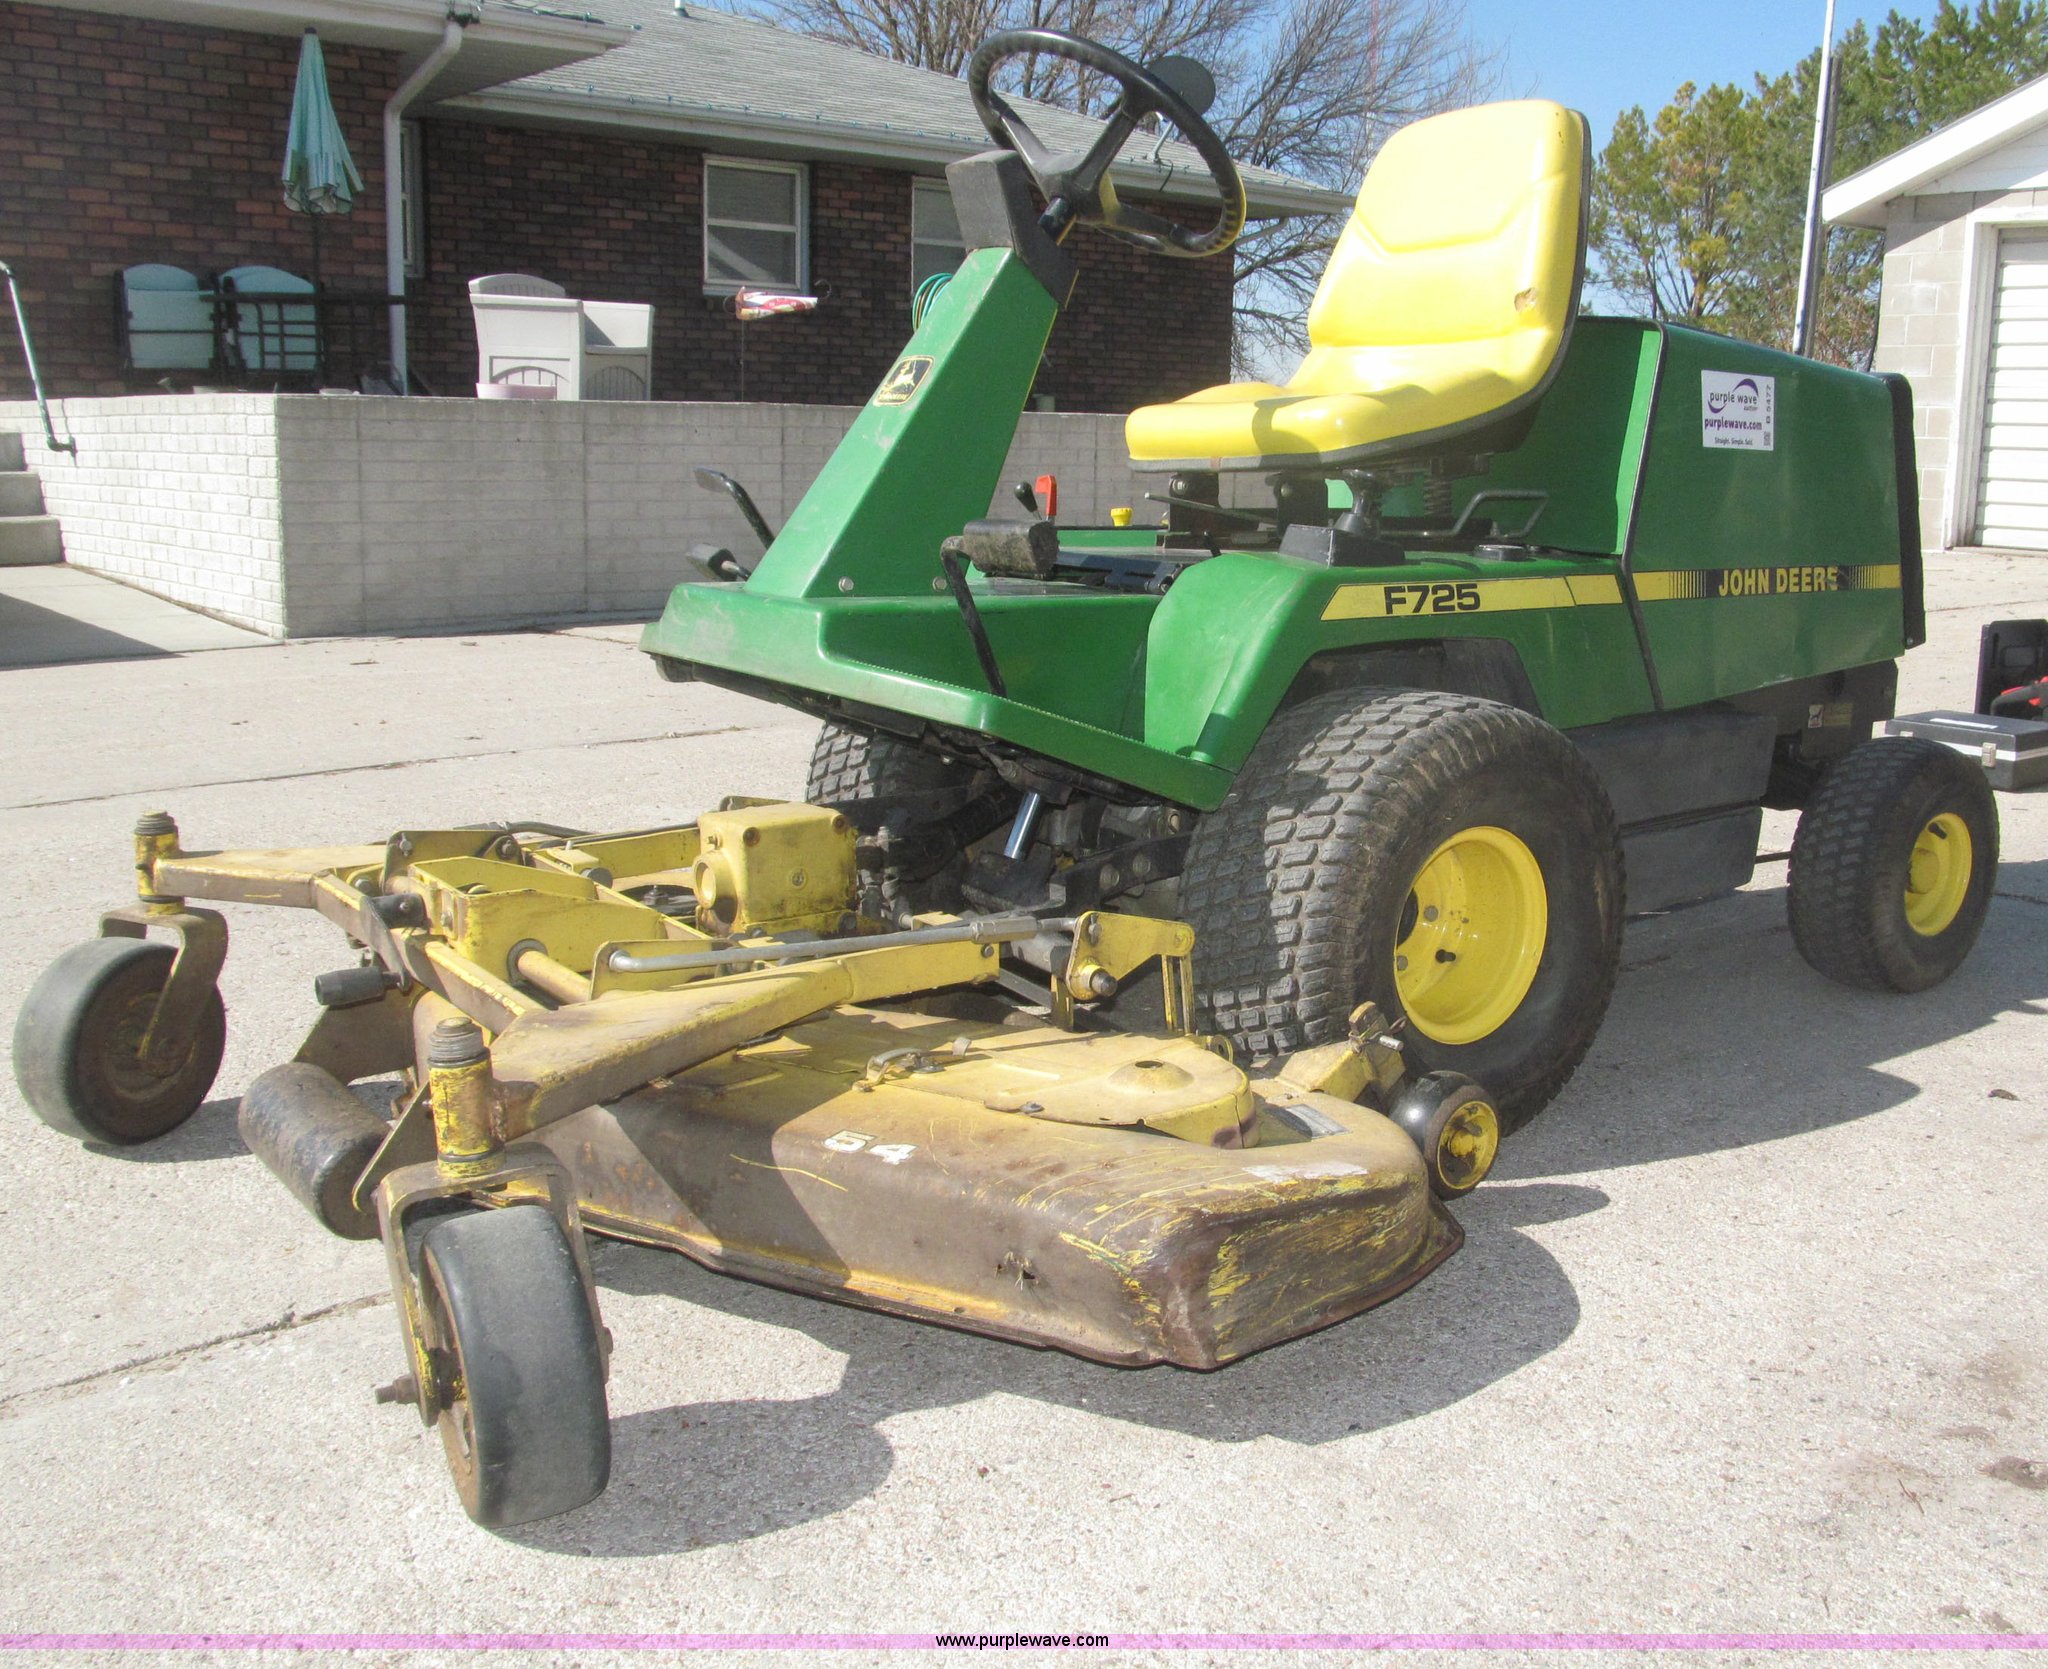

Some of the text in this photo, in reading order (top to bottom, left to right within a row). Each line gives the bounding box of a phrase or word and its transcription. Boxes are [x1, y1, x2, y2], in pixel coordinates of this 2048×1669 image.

[1710, 391, 1757, 405] purple wave
[1704, 416, 1762, 430] purplewave.com
[1719, 566, 1839, 597] JOHN DEERE
[1383, 582, 1481, 615] F725
[823, 1129, 919, 1165] 54
